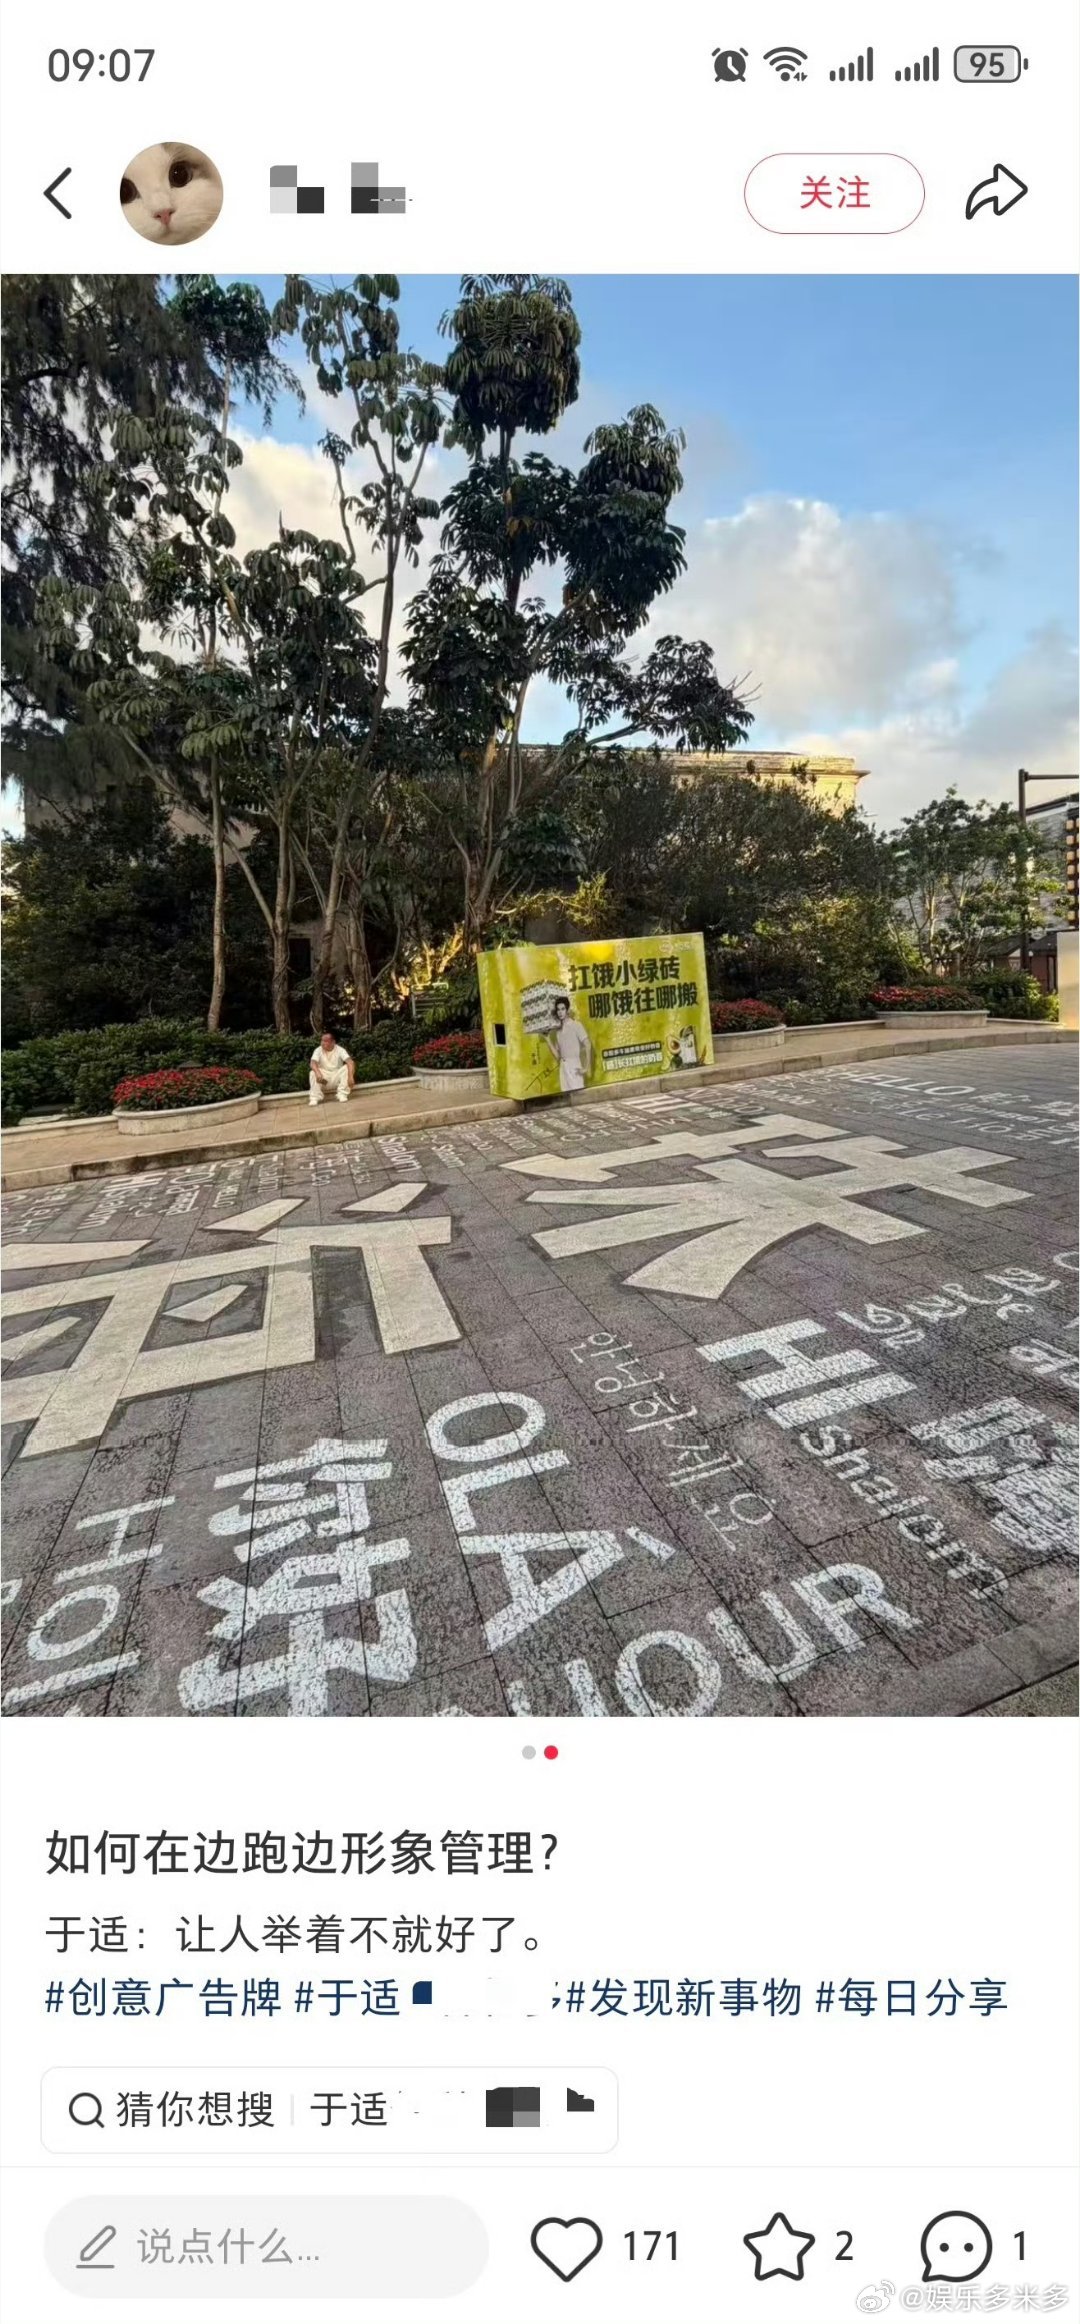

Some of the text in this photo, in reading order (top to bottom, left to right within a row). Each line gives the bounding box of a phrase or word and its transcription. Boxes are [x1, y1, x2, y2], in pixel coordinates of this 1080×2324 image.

[48, 48, 155, 82] 09:07
[969, 51, 1006, 77] 95
[800, 175, 870, 209] 关注
[568, 955, 681, 992] 扛饿小绿砖
[588, 981, 699, 1019] 哪饿往哪搬
[827, 1071, 976, 1095] HELLO
[377, 1135, 423, 1174] Shalom
[76, 1187, 140, 1231] Shalom
[696, 1317, 917, 1430] HI
[569, 1332, 776, 1551] 안녕하세요
[424, 1391, 676, 1652] OLÁ
[177, 1437, 418, 1716] 你好
[1, 1494, 176, 1716] Hol
[46, 1829, 557, 1875] 如何在边跑边形象管理?
[45, 1977, 1007, 2017] #创意广告牌 #于适 #发现新事物 #每日分享
[116, 2091, 388, 2127] 猜你想搜 于适
[624, 2231, 678, 2260] 171
[835, 2230, 854, 2260] 2
[1012, 2231, 1026, 2260] 1
